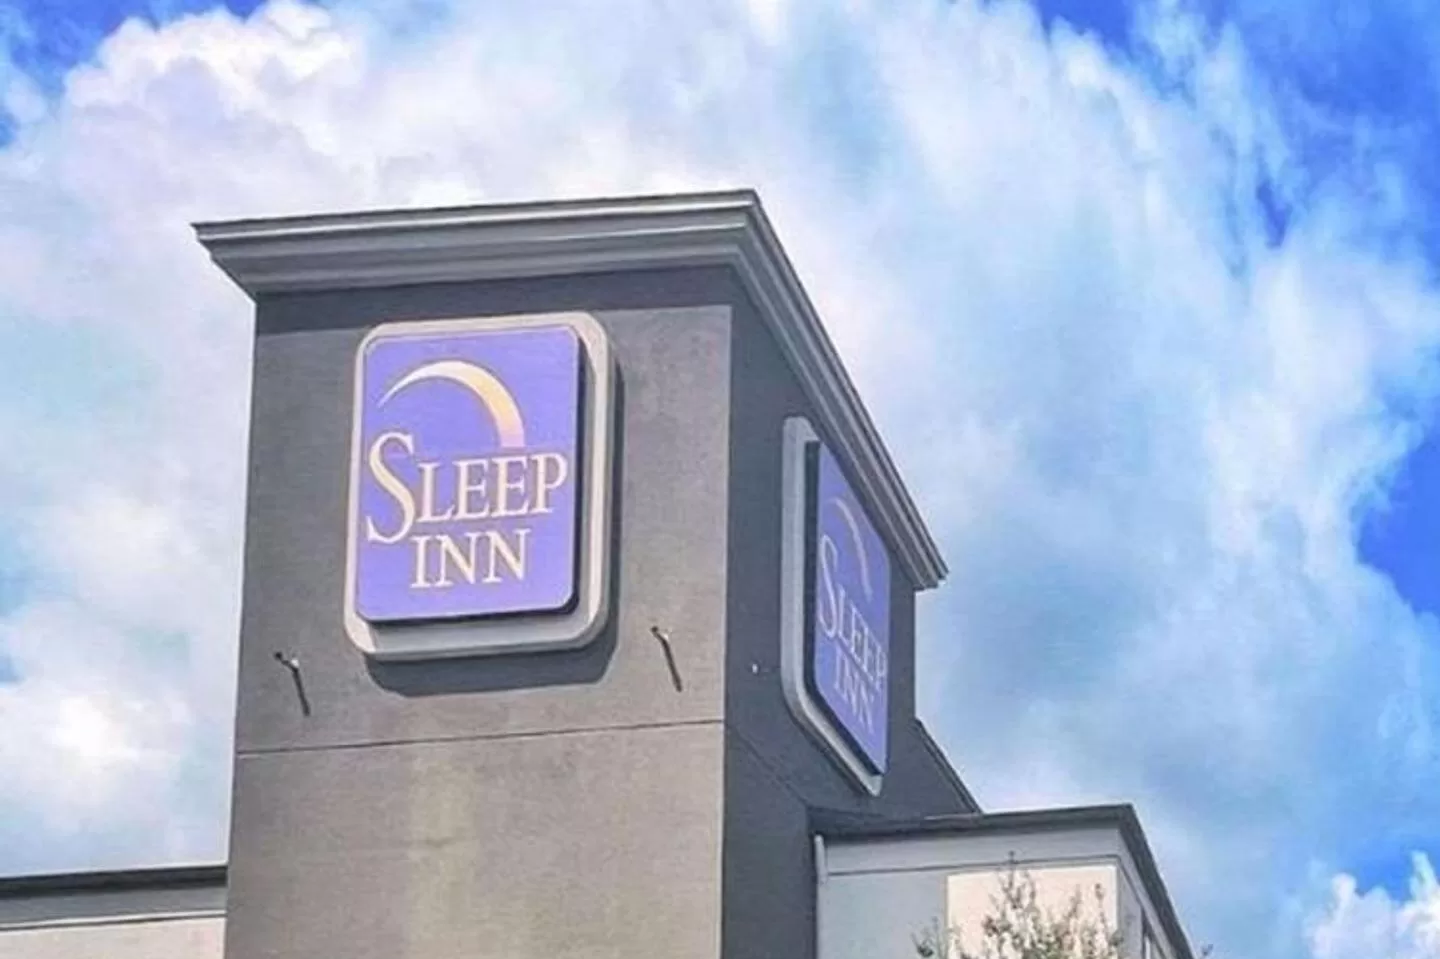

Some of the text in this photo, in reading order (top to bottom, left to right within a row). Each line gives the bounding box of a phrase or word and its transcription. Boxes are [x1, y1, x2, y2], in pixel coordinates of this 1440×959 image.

[366, 431, 569, 544] SLEEP
[410, 527, 532, 589] INN
[818, 534, 887, 692] SLEEP
[834, 653, 875, 735] INN
